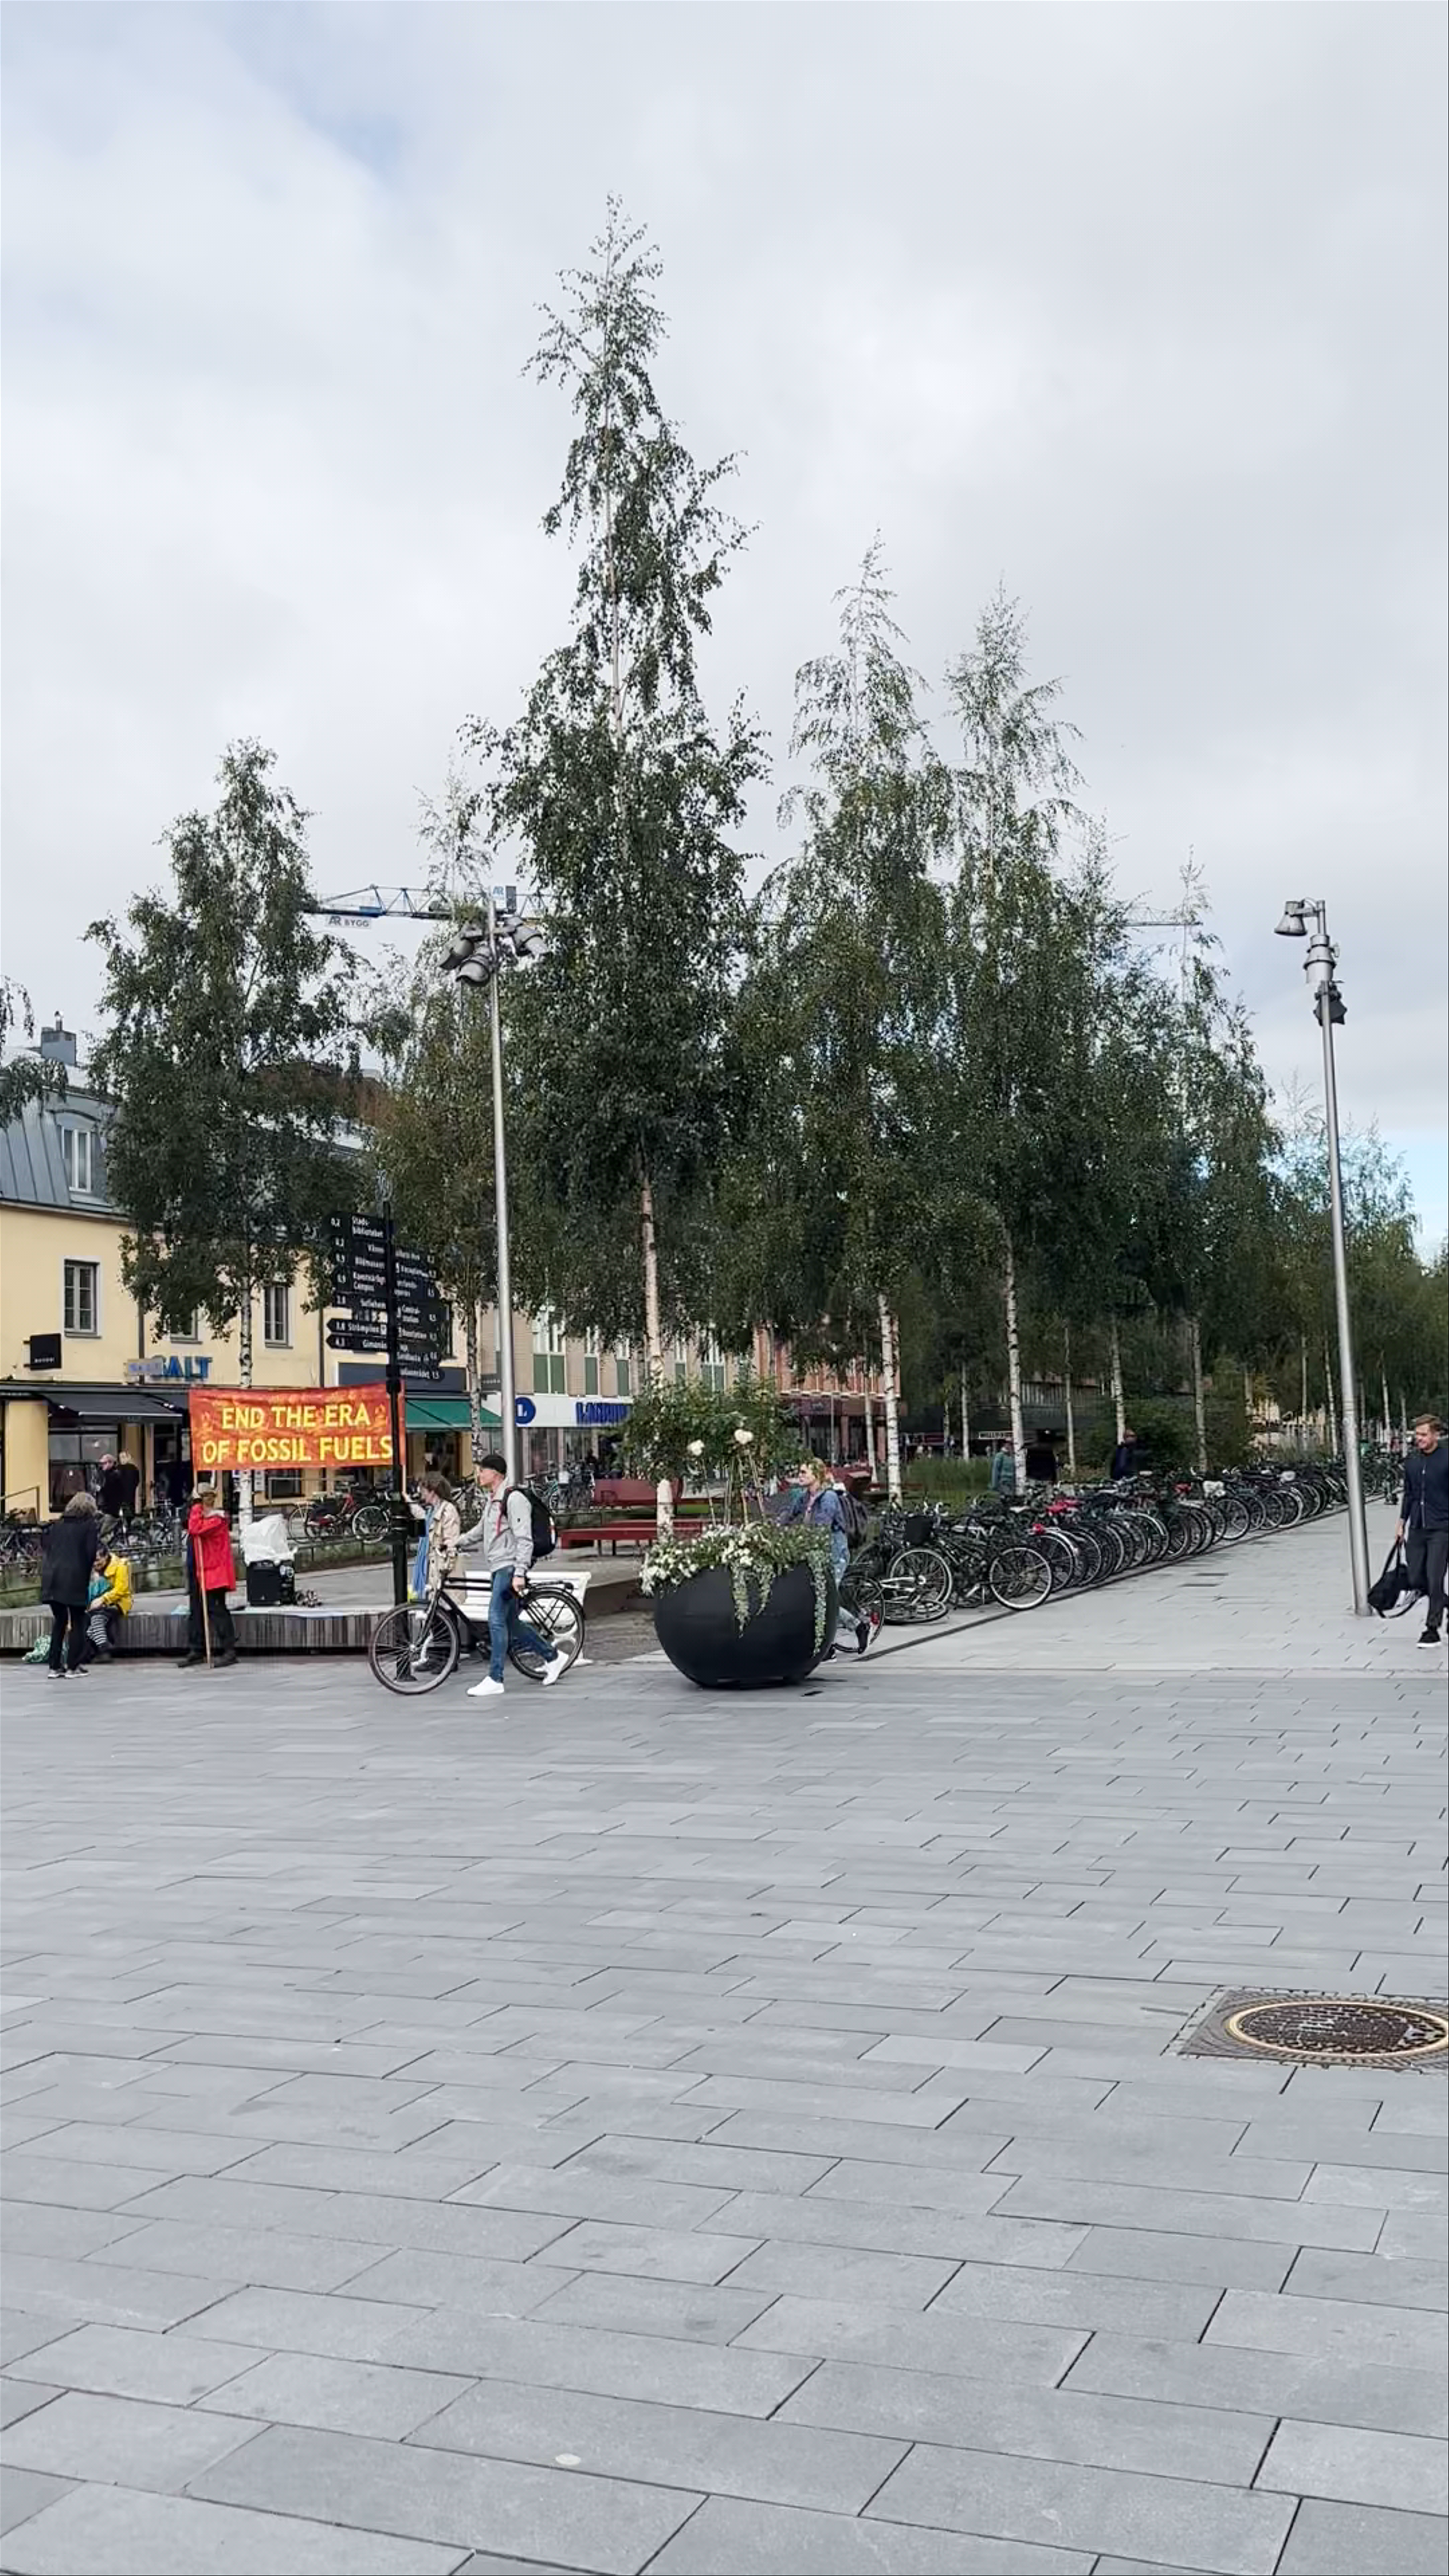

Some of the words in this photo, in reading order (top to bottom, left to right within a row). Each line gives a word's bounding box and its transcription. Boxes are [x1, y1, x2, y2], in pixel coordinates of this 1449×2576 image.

[493, 886, 504, 895] AR
[328, 915, 342, 926] AR
[345, 919, 369, 927] BYGG
[222, 1406, 265, 1429] END
[271, 1405, 317, 1428] THE
[325, 1402, 371, 1427] ERA
[202, 1439, 229, 1464] OF
[237, 1438, 311, 1463] FOSSIL
[320, 1435, 393, 1461] FUELS
